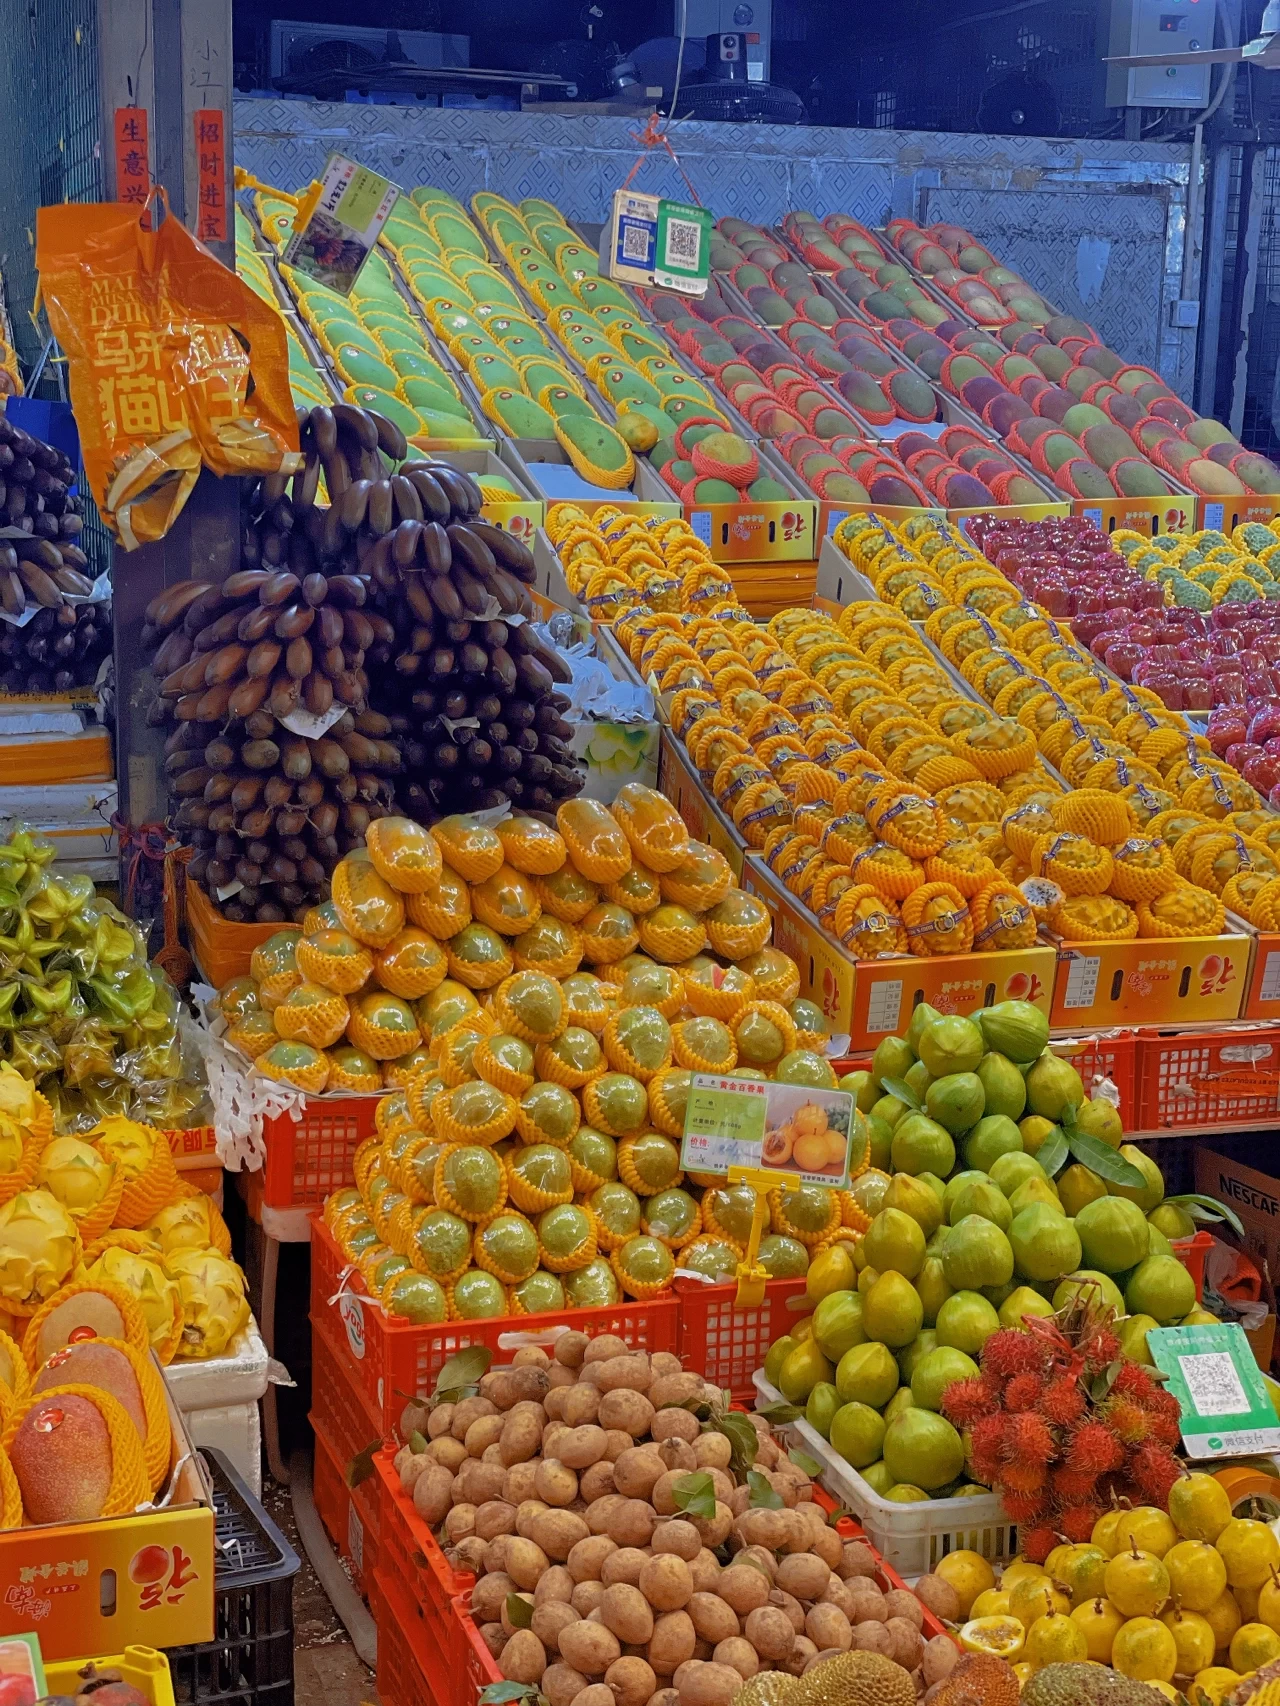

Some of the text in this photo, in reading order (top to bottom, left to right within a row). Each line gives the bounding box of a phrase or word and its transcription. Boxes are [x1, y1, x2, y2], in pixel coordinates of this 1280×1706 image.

[720, 1080, 765, 1094] 黄金百香果
[1224, 1432, 1264, 1447] 微信支付
[129, 1545, 199, 1611] 福
[5, 1585, 51, 1621] 海南
